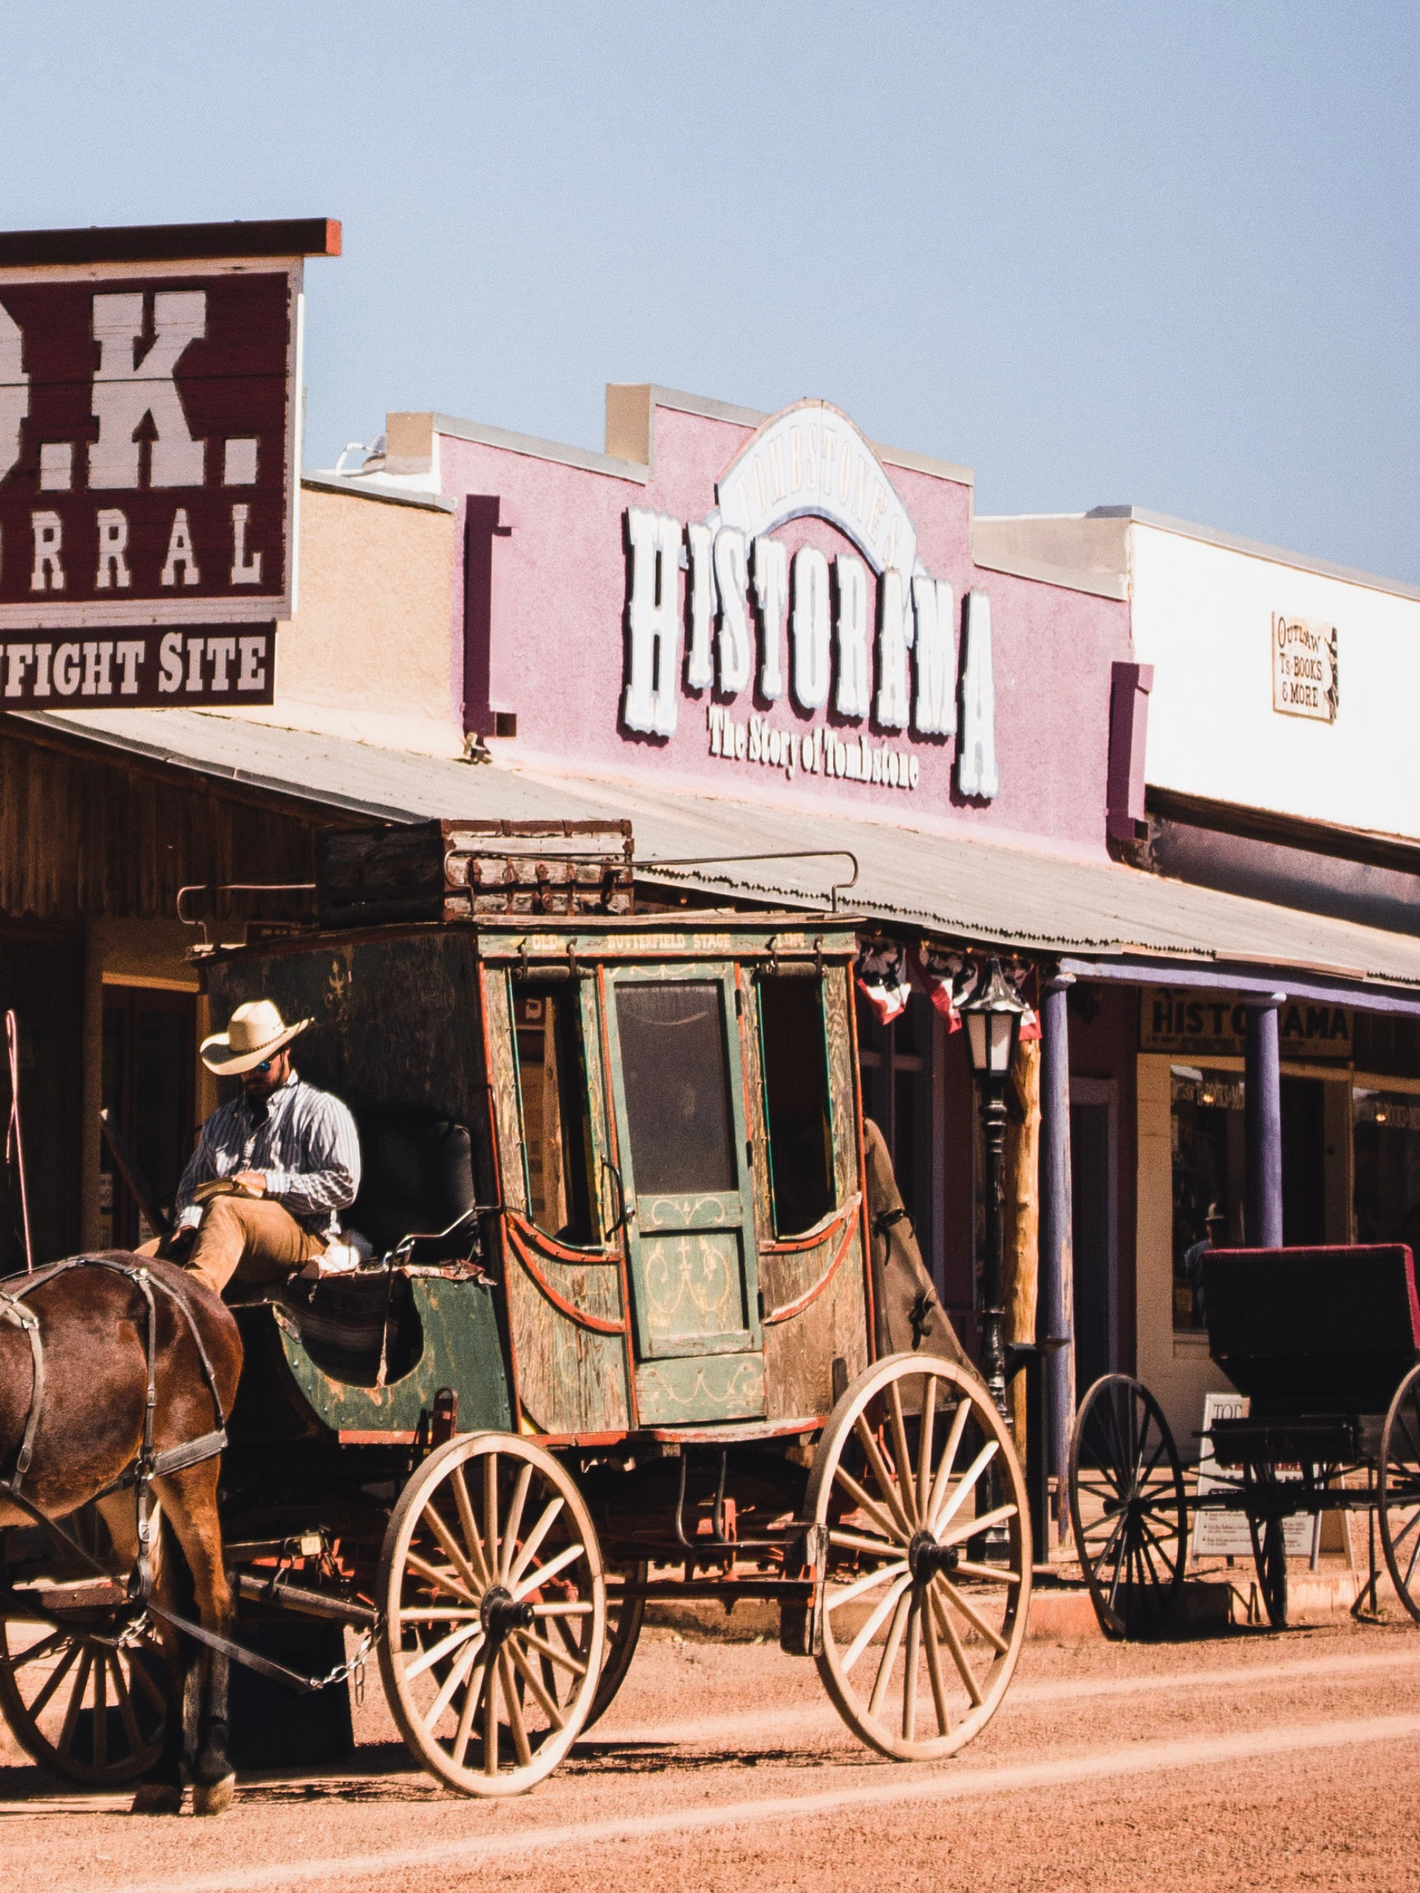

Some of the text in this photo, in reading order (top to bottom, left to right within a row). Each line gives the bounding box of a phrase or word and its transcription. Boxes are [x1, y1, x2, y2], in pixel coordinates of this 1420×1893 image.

[624, 507, 999, 798] HISTORAMA
[1289, 681, 1319, 708] MORE
[707, 705, 920, 789] The Story of Tombstone
[531, 934, 558, 951] OLD
[606, 934, 686, 951] BUTTERFIELD
[693, 933, 732, 949] STAGE
